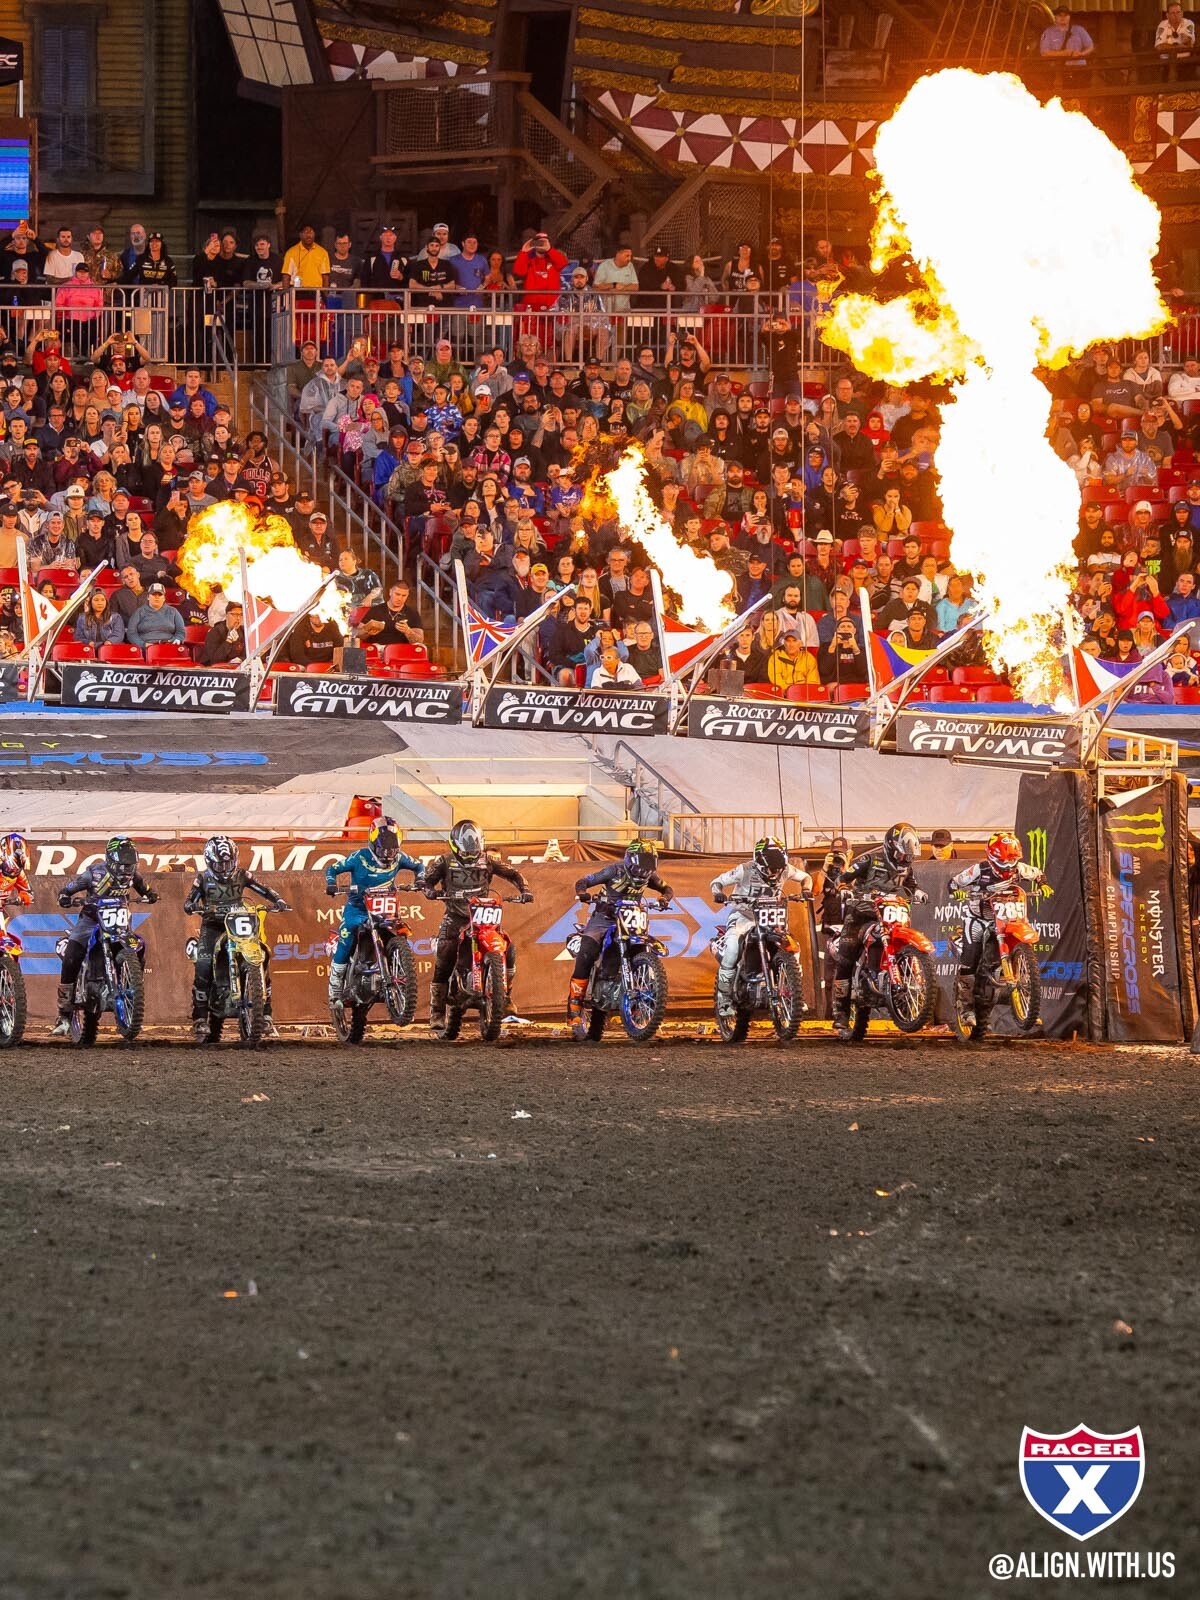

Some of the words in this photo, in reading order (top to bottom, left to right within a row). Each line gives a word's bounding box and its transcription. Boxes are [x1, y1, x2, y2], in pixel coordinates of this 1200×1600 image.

[102, 670, 153, 685] ROCKY
[154, 672, 238, 689] MOUNTAIN
[316, 680, 368, 695] ROCKY
[370, 683, 451, 701] MOUNTAIN
[523, 691, 572, 706] ROCKY
[573, 694, 656, 712] MOUNTAIN
[727, 703, 776, 721] ROCKY
[778, 708, 858, 725] MOUNTAIN
[935, 719, 984, 735] ROCKY
[985, 722, 1066, 740] MOUNTAIN
[1132, 856, 1141, 875] AMA
[372, 897, 397, 914] 96
[472, 906, 503, 924] 460
[883, 905, 909, 923] 66
[994, 902, 1026, 919] 285
[101, 908, 129, 928] 58
[235, 916, 253, 936] 6
[759, 908, 786, 927] 832
[277, 934, 300, 943] AMA
[1105, 886, 1121, 980] CHAMPIONSHIP
[1119, 852, 1141, 1015] SUPERCROSS
[1139, 903, 1148, 964] ENERGY
[1147, 890, 1165, 977] MONSTER
